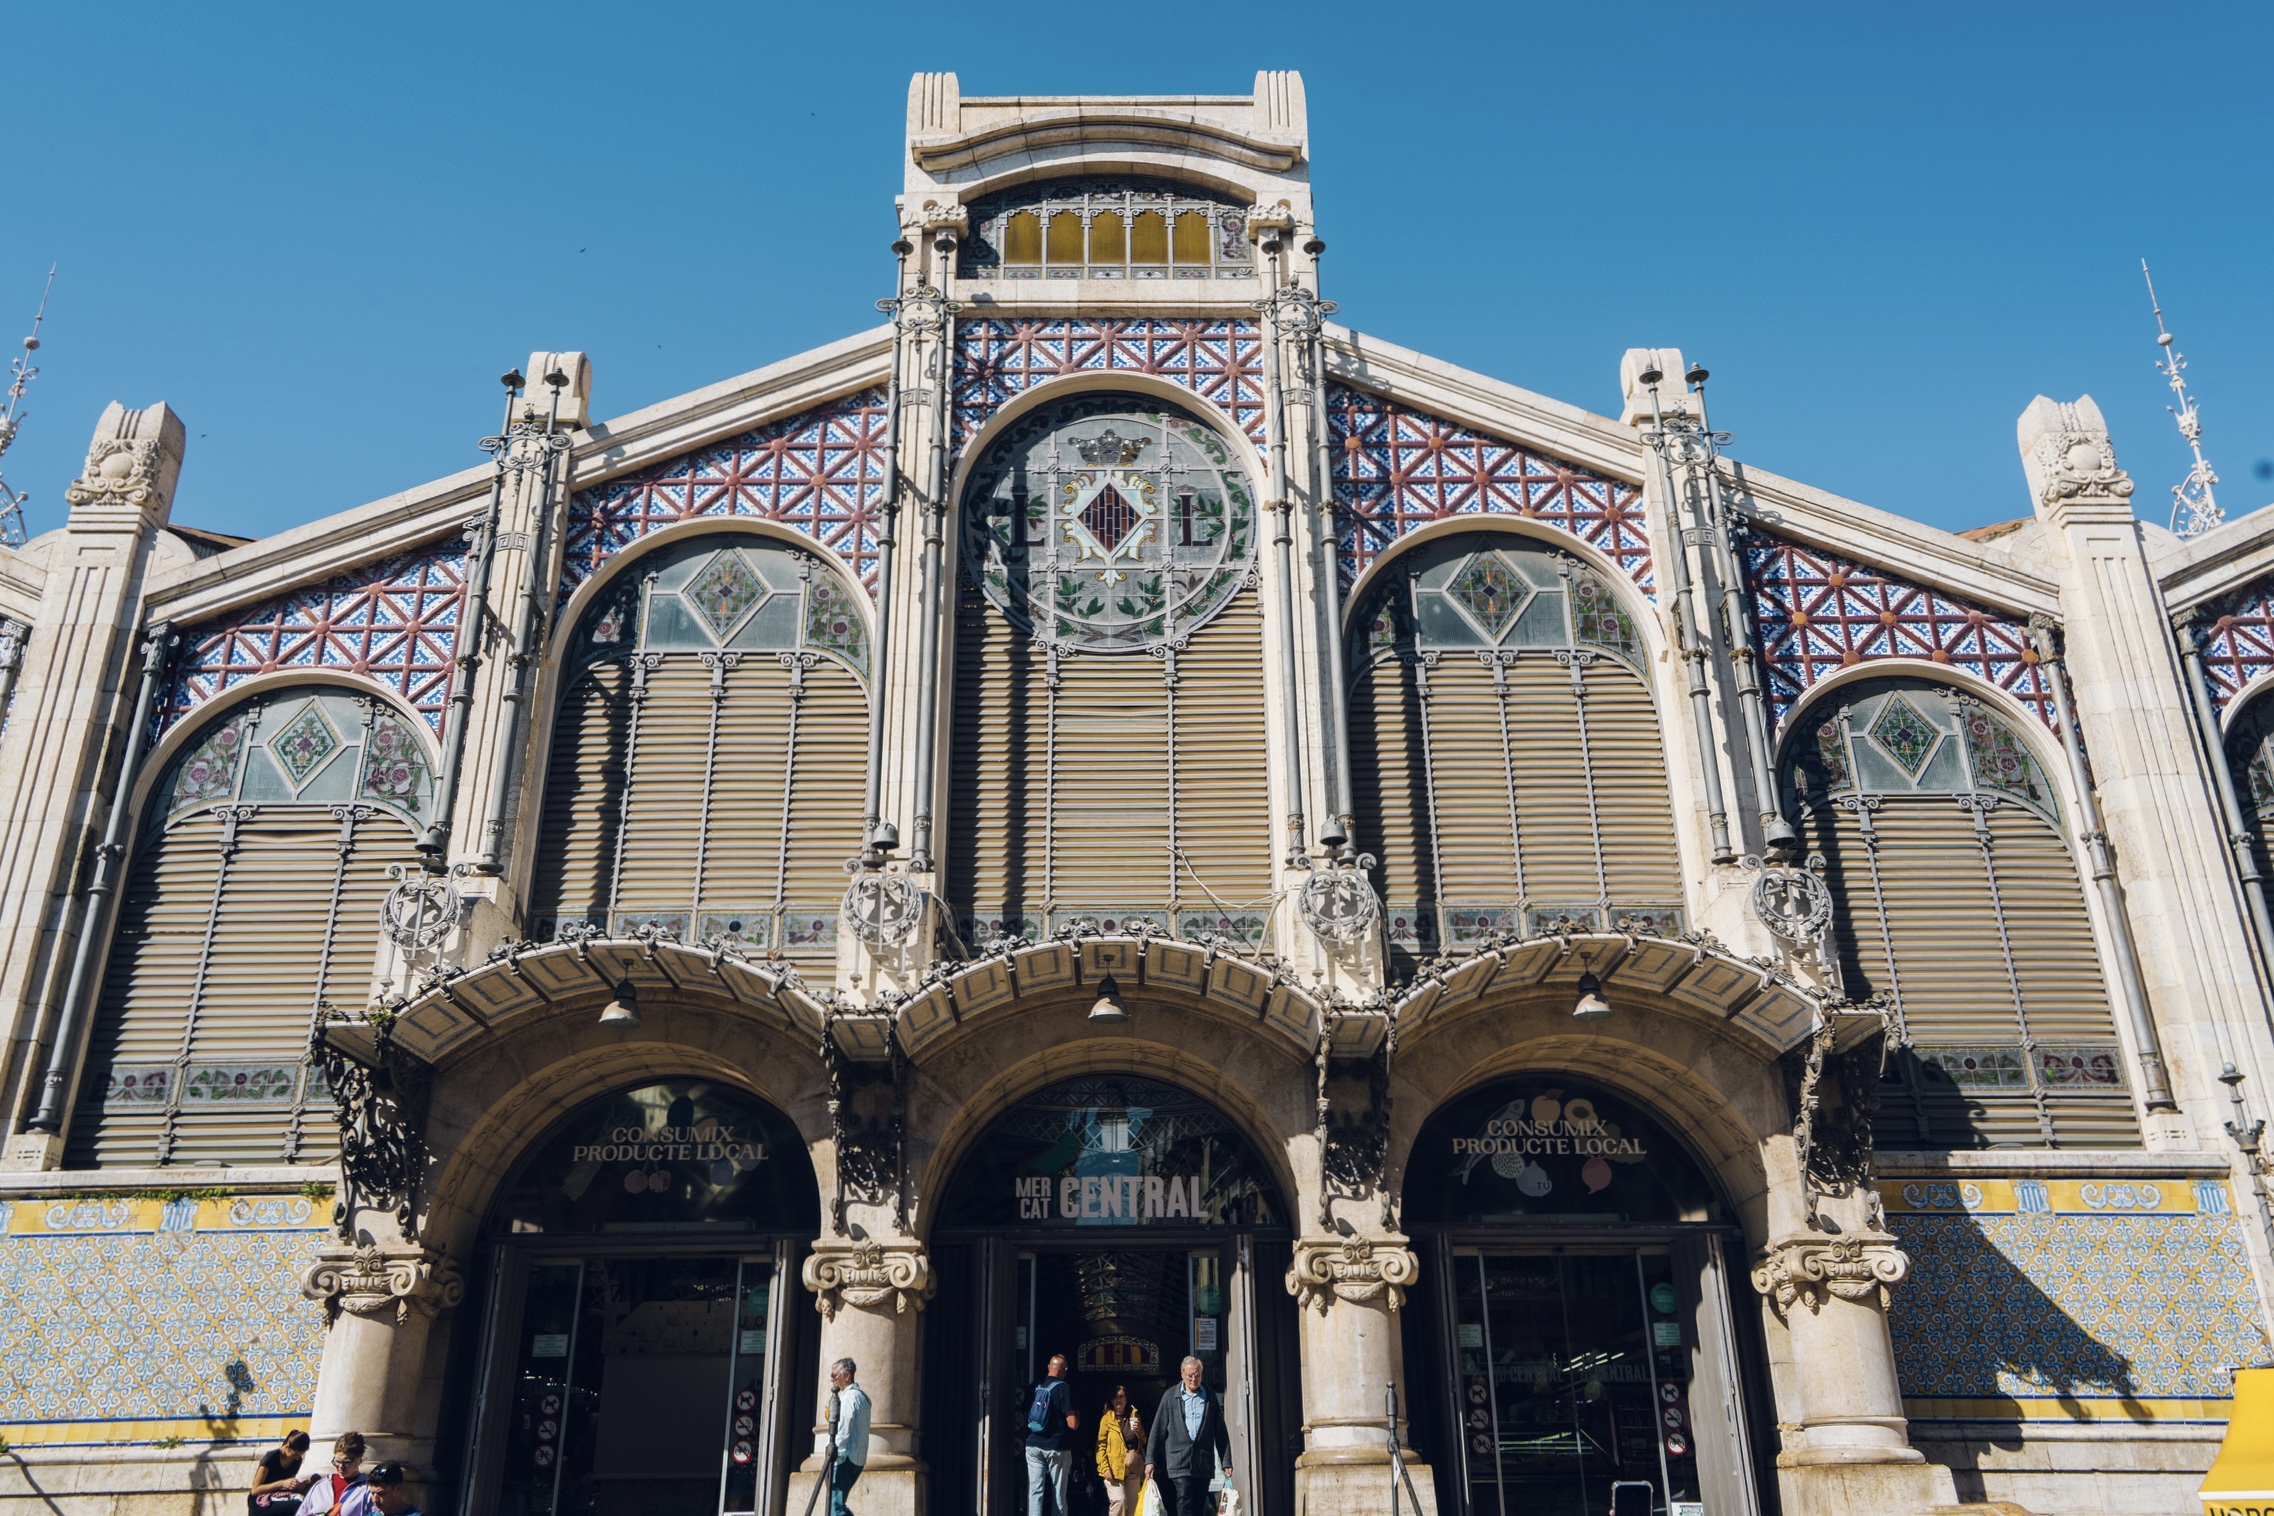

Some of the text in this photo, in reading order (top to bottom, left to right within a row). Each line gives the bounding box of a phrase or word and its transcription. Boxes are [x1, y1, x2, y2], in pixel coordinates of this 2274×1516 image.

[613, 1125, 735, 1143] CONSUMIX
[1487, 1119, 1608, 1137] CONSUMIX
[572, 1143, 769, 1162] PRODUCTE LOCAL
[1452, 1138, 1647, 1155] PRODUCTE LOCAL
[1015, 1176, 1051, 1197] MER
[1059, 1175, 1208, 1218] CENTRAL
[1020, 1197, 1051, 1219] CAT
